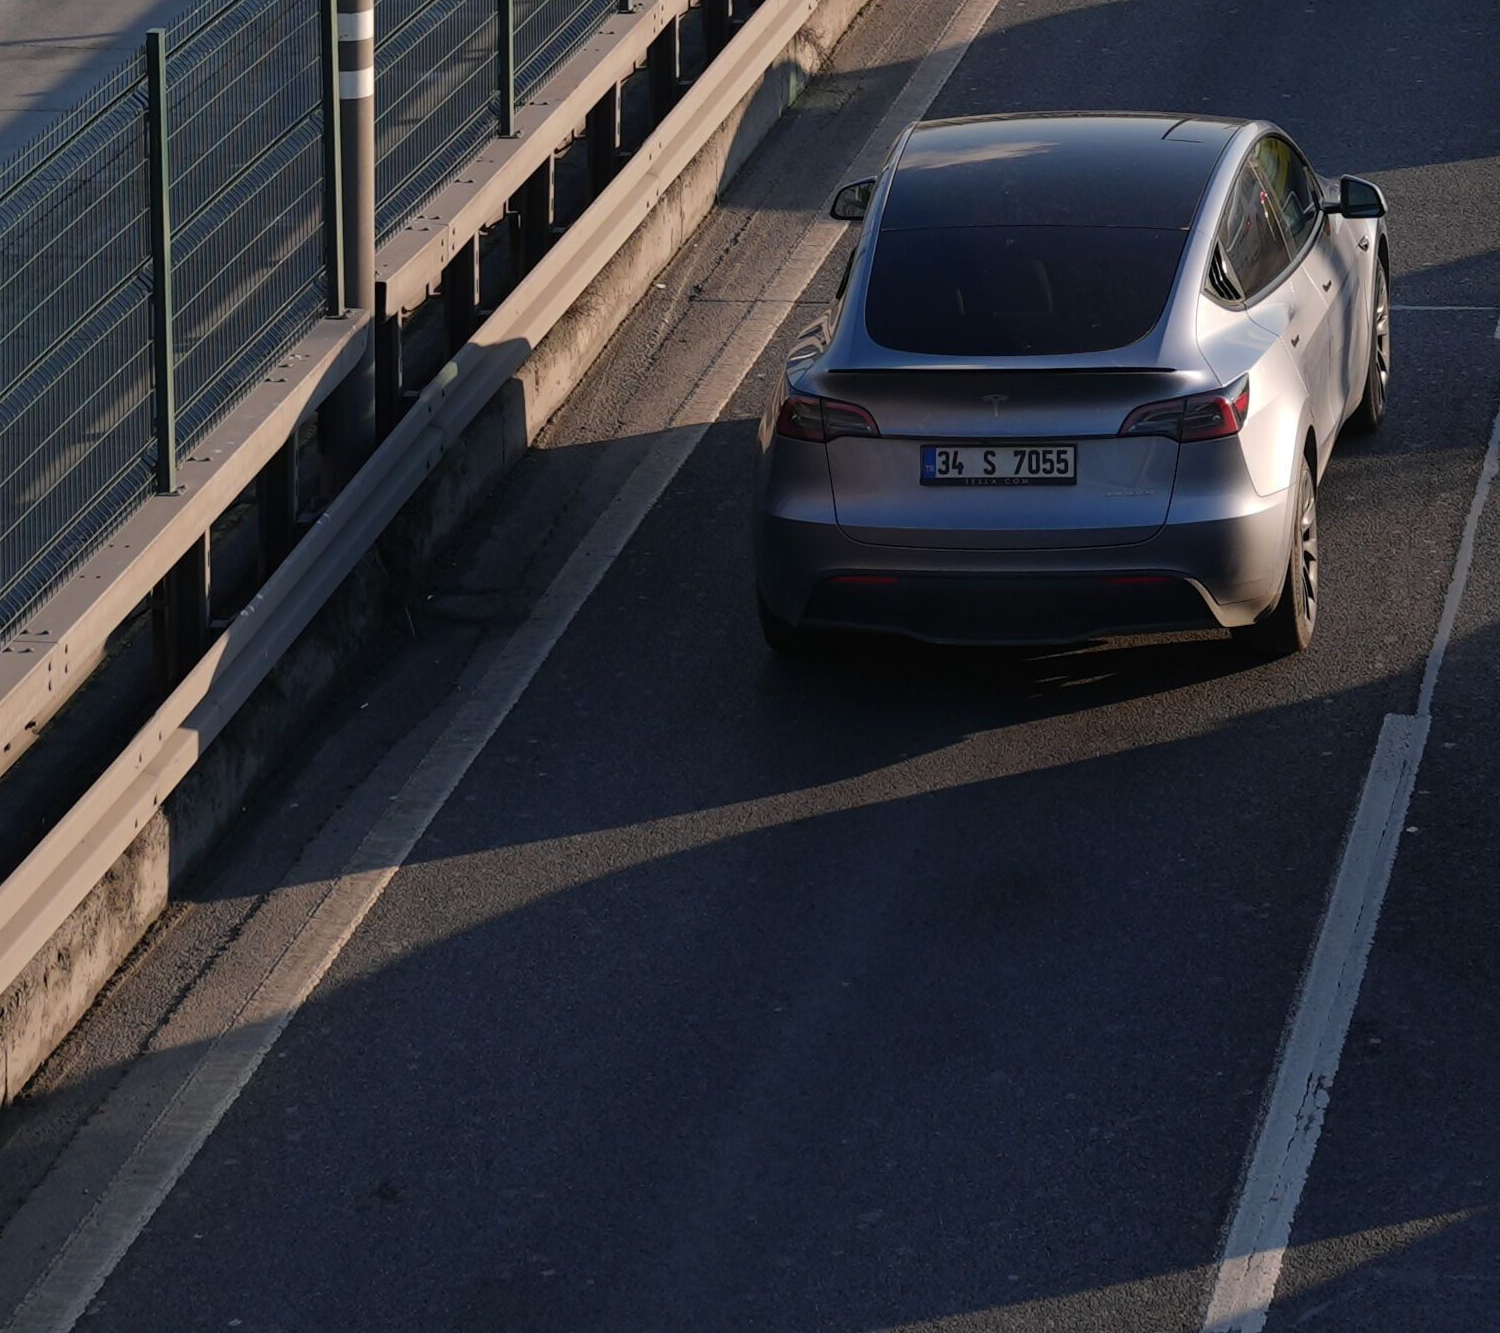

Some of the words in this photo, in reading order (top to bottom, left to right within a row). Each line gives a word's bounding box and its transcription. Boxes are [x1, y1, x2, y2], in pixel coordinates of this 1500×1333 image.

[937, 451, 964, 476] 34
[983, 451, 997, 476] S
[1013, 450, 1070, 476] 7055
